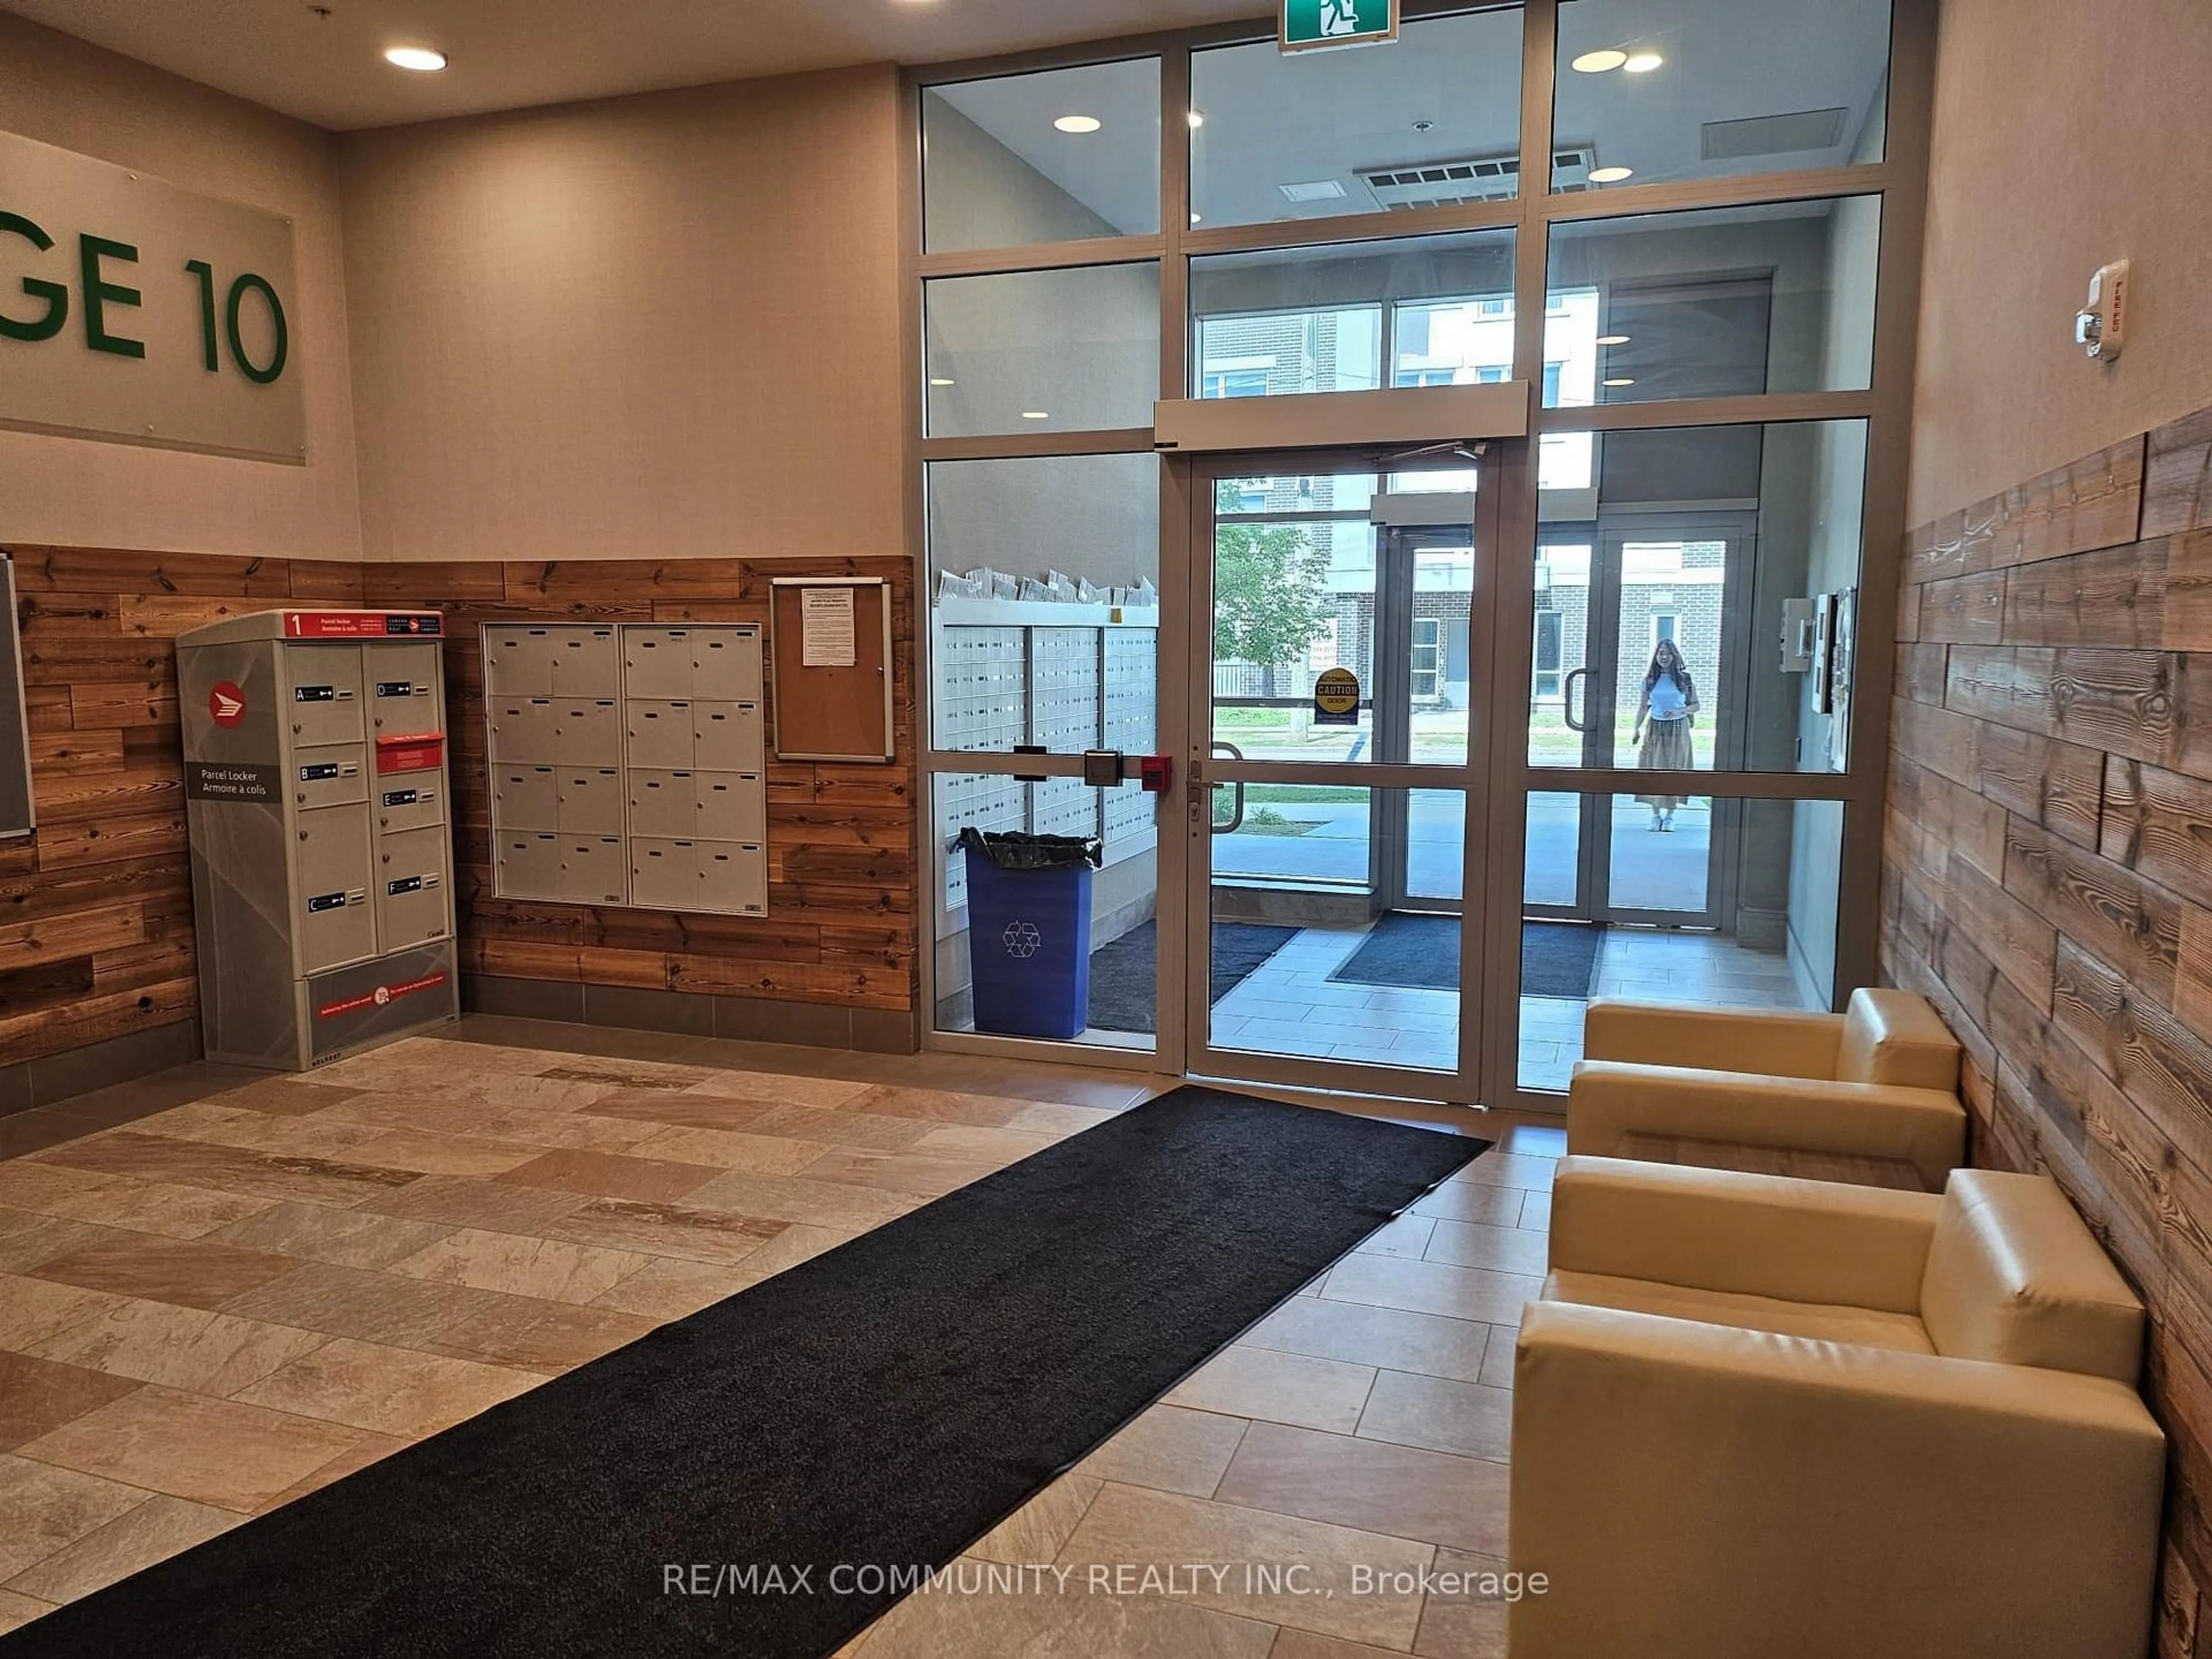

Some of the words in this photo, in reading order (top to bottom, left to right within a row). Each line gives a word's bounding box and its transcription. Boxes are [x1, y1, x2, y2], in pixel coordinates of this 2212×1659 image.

[185, 259, 288, 384] 10
[291, 615, 301, 635] 1
[297, 690, 304, 700] A
[377, 685, 385, 695] D
[1317, 685, 1357, 694] CAUTION
[202, 769, 227, 780] Parcel
[229, 770, 257, 781] Locker
[302, 768, 308, 779] B
[203, 783, 237, 793] Armoire
[239, 783, 245, 794] à
[246, 784, 266, 795] colis
[385, 794, 392, 805] E
[390, 884, 396, 893] F
[310, 900, 317, 910] C
